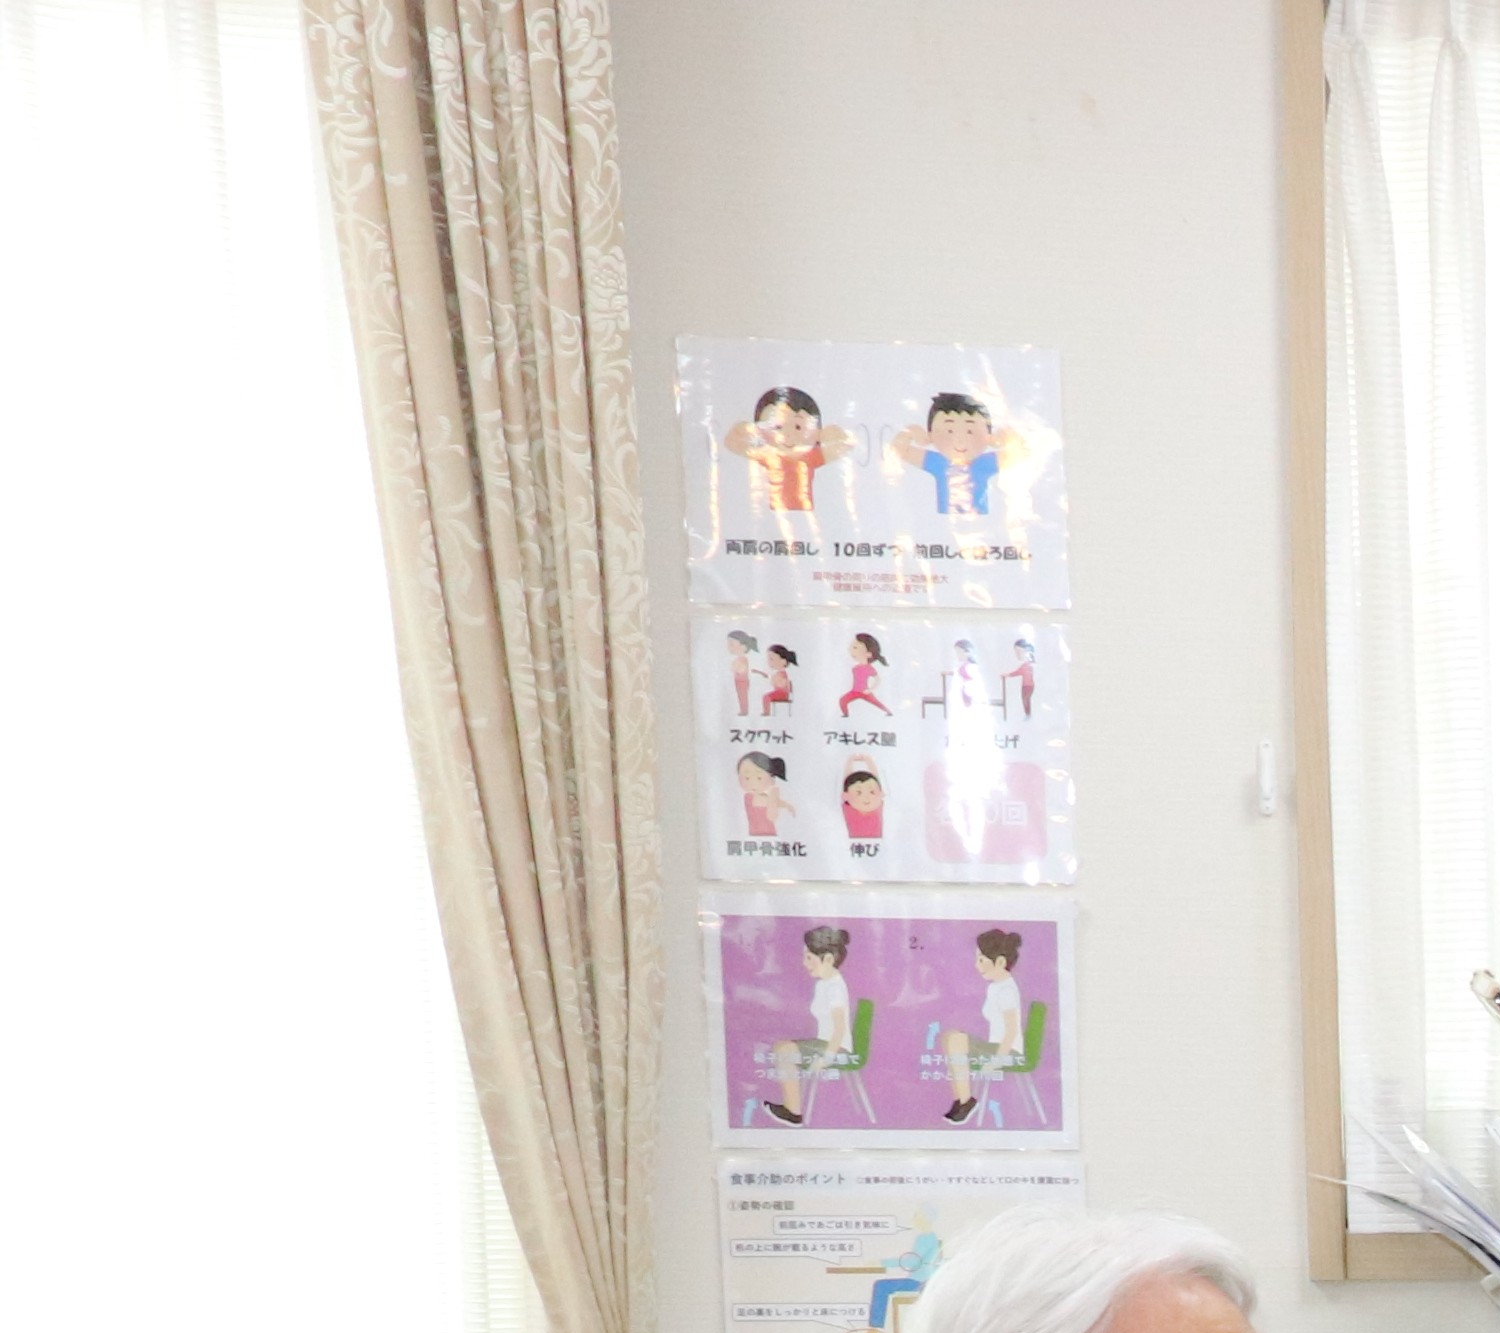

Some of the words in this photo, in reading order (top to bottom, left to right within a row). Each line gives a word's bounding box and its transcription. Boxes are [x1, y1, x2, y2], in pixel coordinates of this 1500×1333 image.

[730, 729, 794, 745] スクワット
[824, 730, 897, 747] アキレス腱
[726, 840, 807, 857] 肩甲骨強化
[850, 842, 880, 857] 伸び
[730, 1172, 846, 1187] 食事介助のポイント
